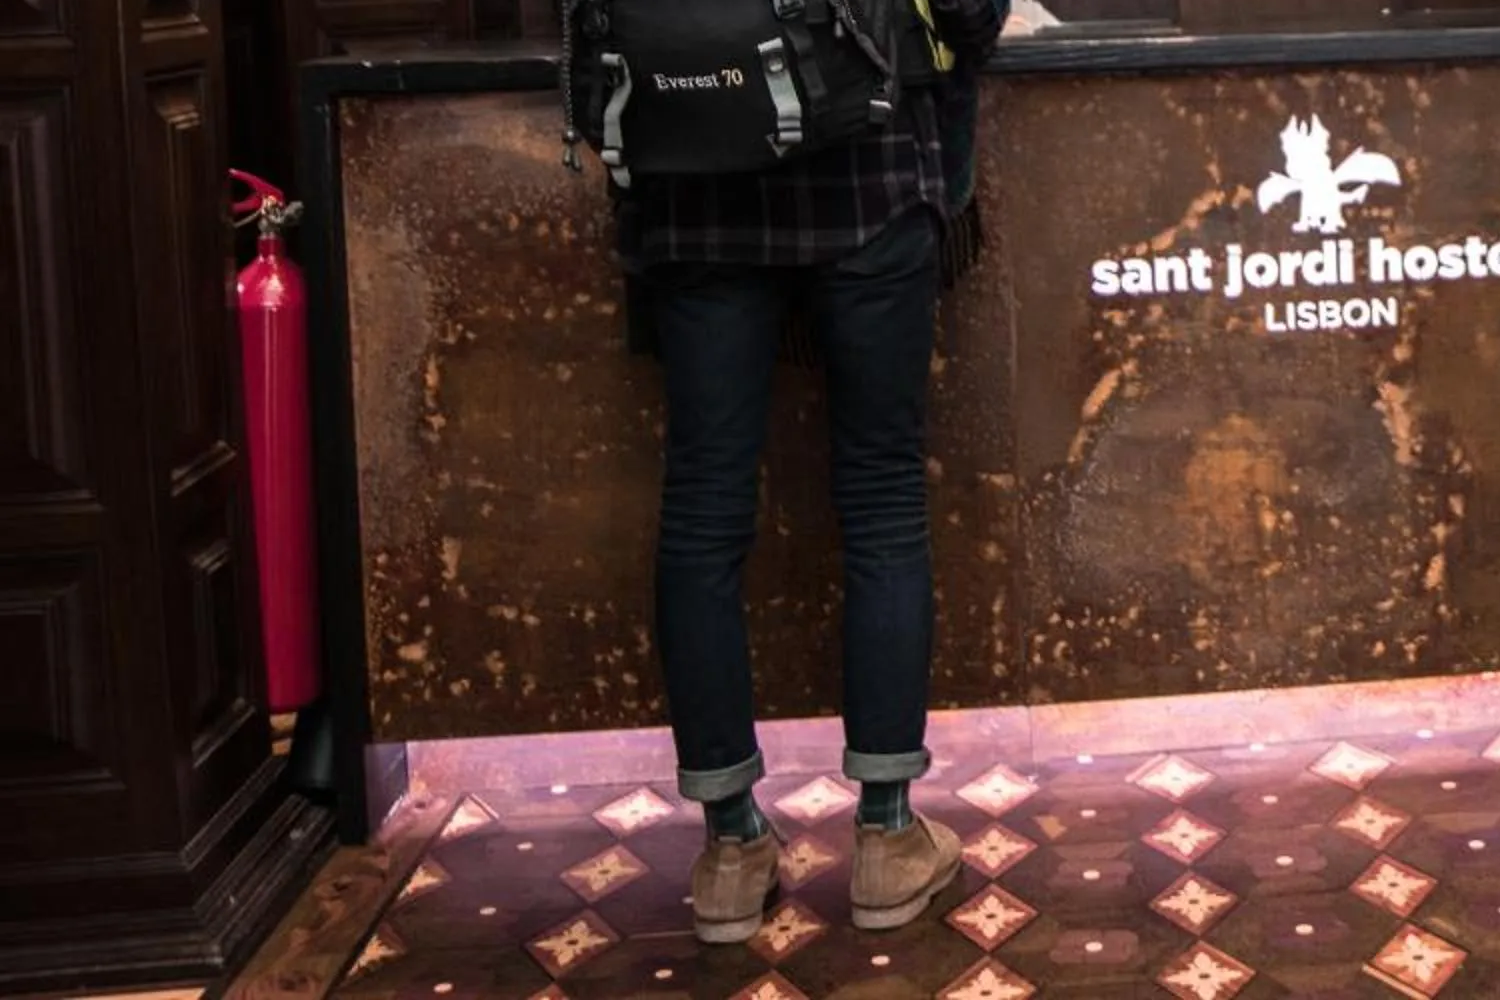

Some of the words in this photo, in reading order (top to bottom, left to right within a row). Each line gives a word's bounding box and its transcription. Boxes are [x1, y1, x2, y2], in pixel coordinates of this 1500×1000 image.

[653, 73, 719, 89] Everest
[721, 68, 743, 88] 70
[1091, 246, 1213, 295] sant
[1223, 237, 1356, 298] jordi
[1264, 296, 1398, 332] LISBON
